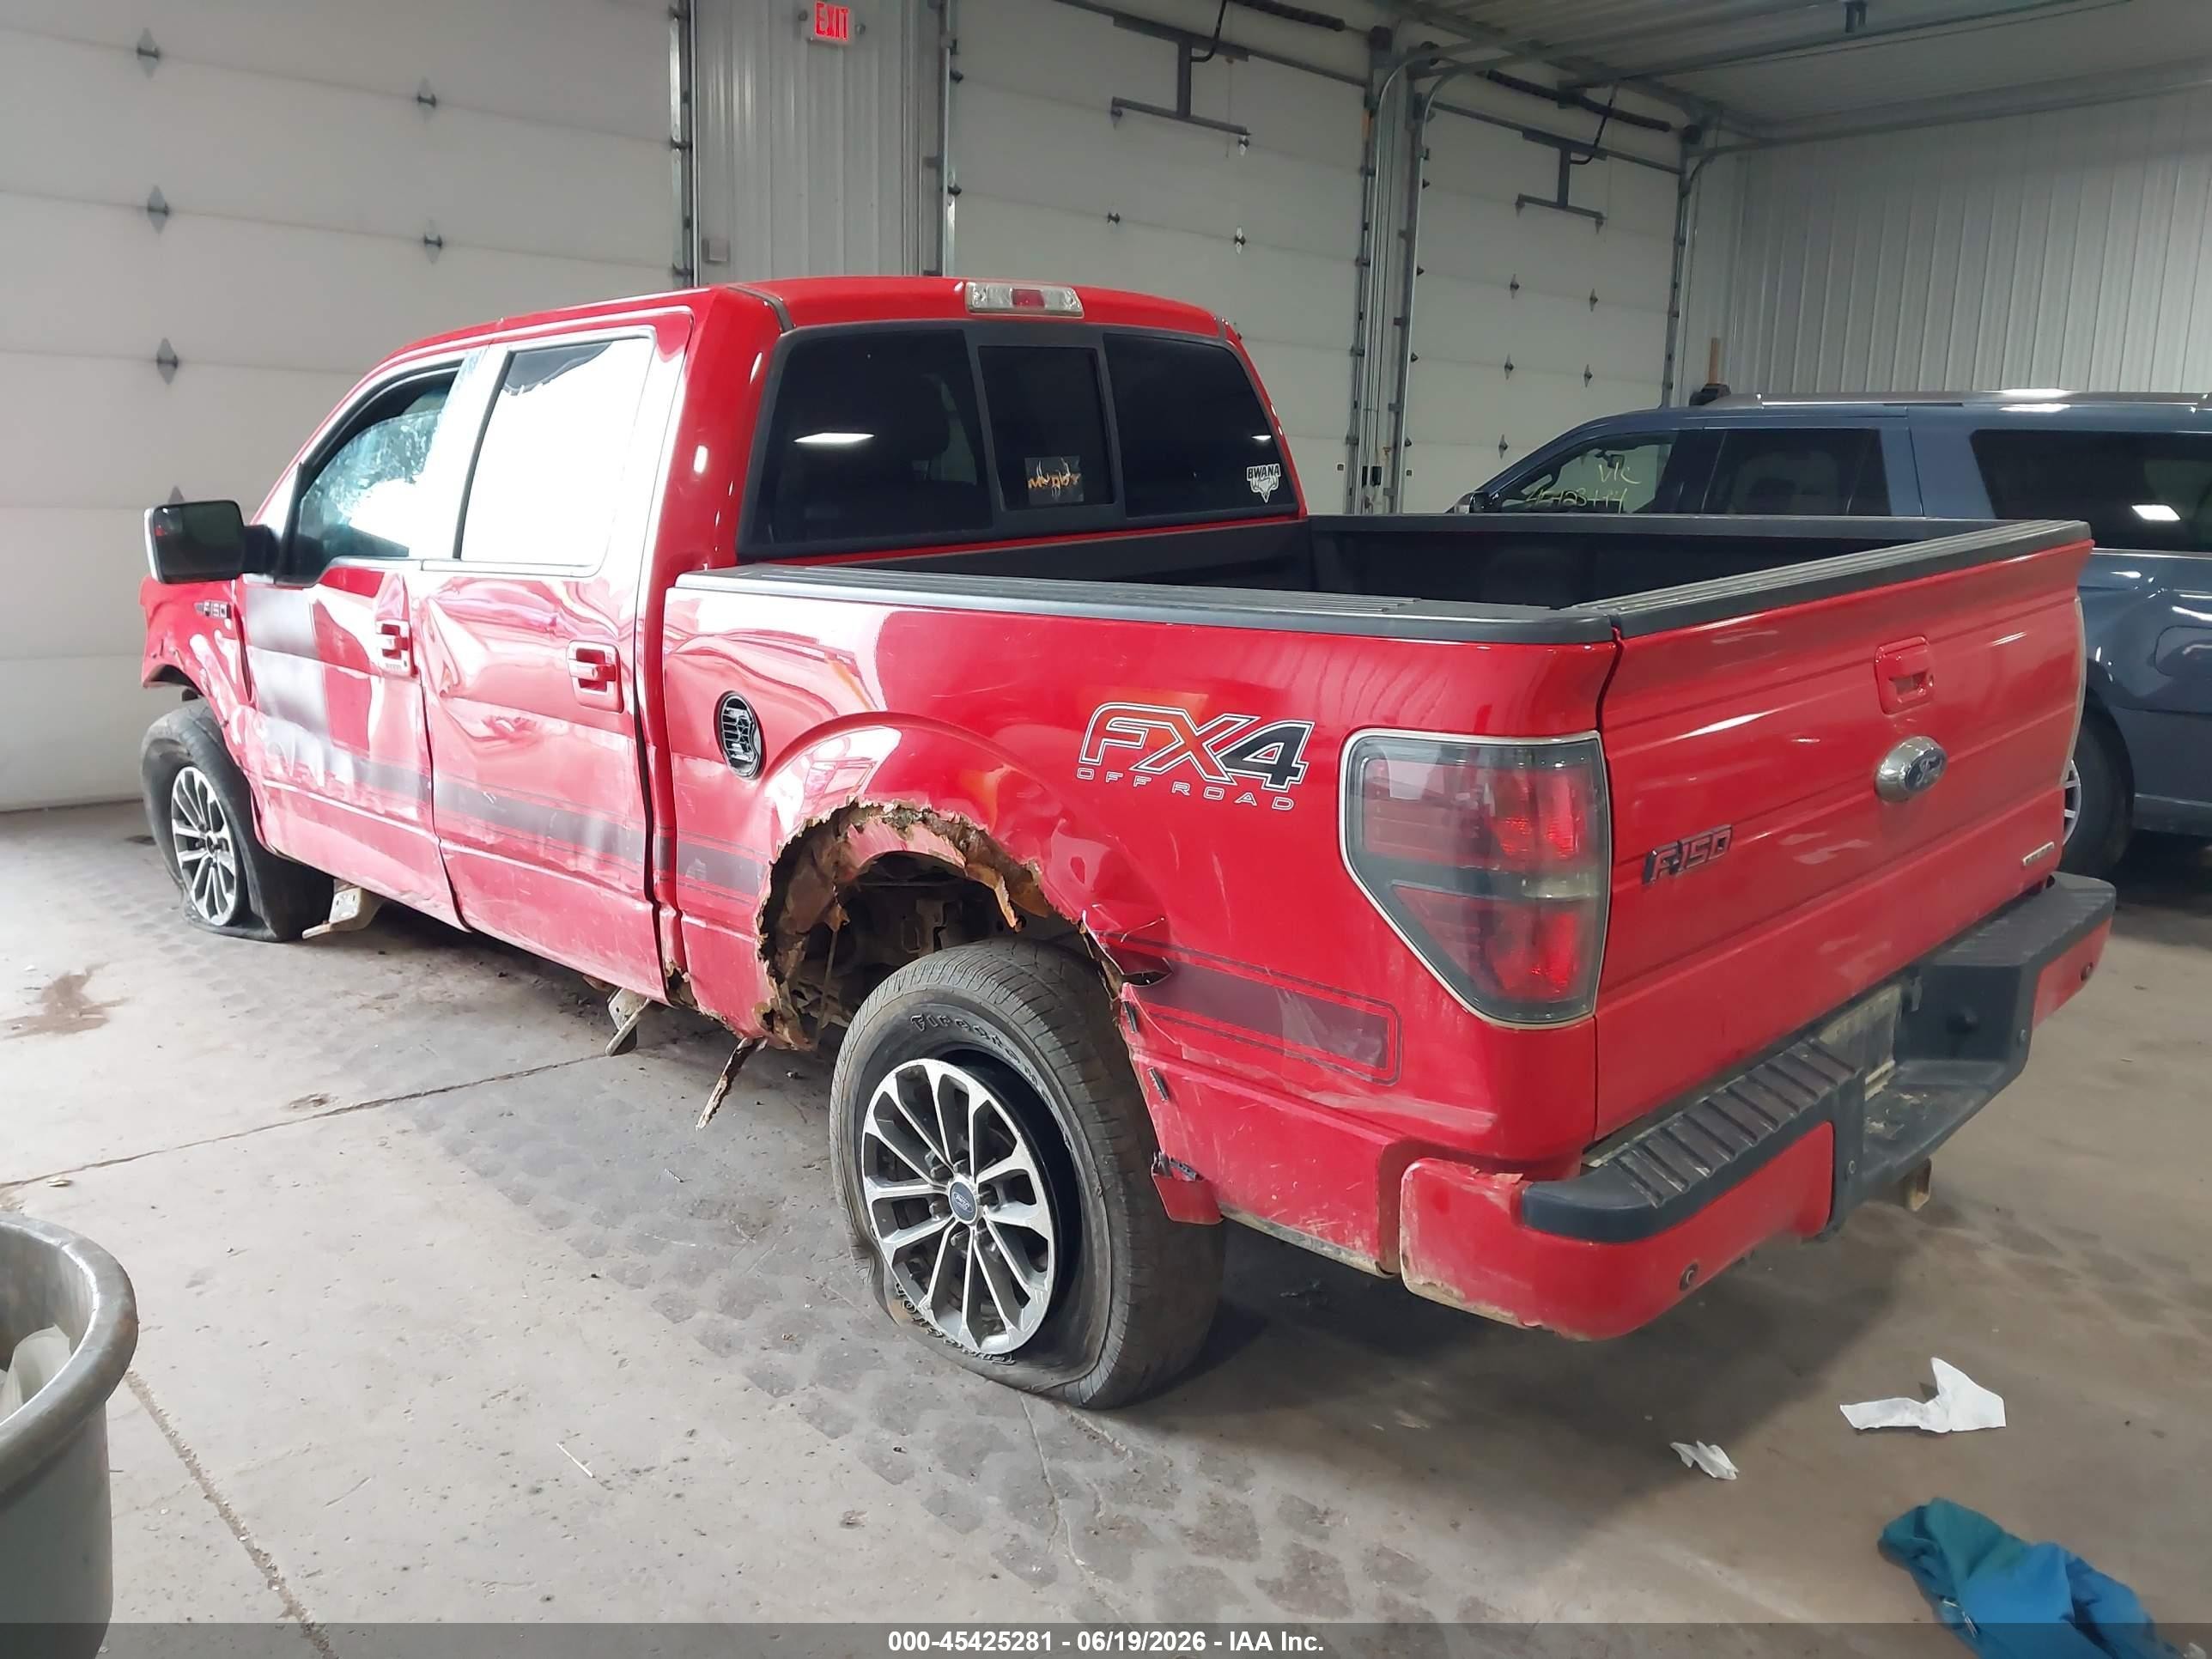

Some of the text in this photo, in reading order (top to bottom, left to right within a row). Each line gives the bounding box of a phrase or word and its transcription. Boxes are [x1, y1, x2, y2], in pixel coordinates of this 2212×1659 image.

[816, 2, 848, 41] EXIT
[1248, 465, 1279, 480] BWANA
[1079, 702, 1315, 792] FX4
[1077, 767, 1294, 811] OFF ROAD
